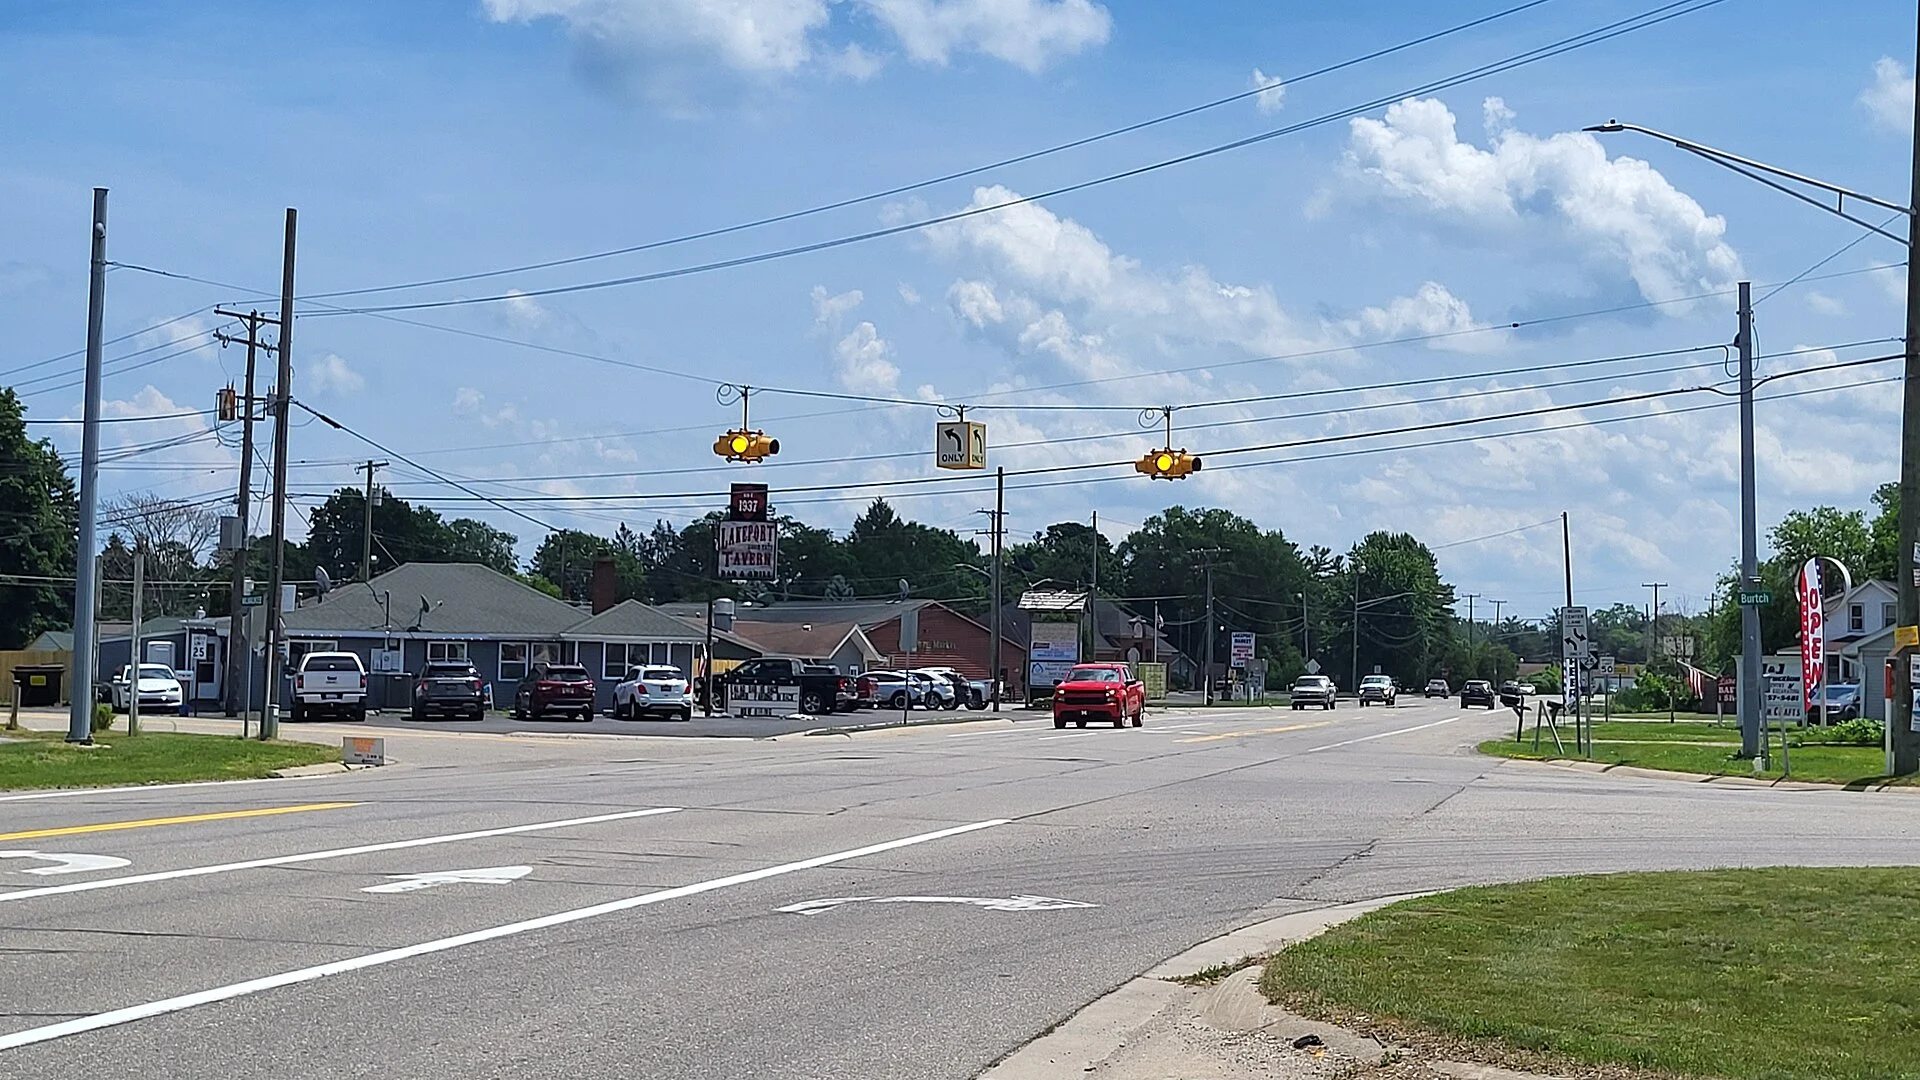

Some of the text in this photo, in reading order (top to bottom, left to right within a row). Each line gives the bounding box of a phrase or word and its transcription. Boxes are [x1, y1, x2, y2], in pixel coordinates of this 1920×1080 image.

[941, 453, 965, 462] ONLY
[739, 500, 758, 512] 1937
[721, 525, 774, 550] LAKEPORT
[721, 551, 772, 567] TAVERN
[1741, 594, 1769, 604] Burtch
[1809, 588, 1824, 685] OPEN
[193, 647, 205, 657] 25
